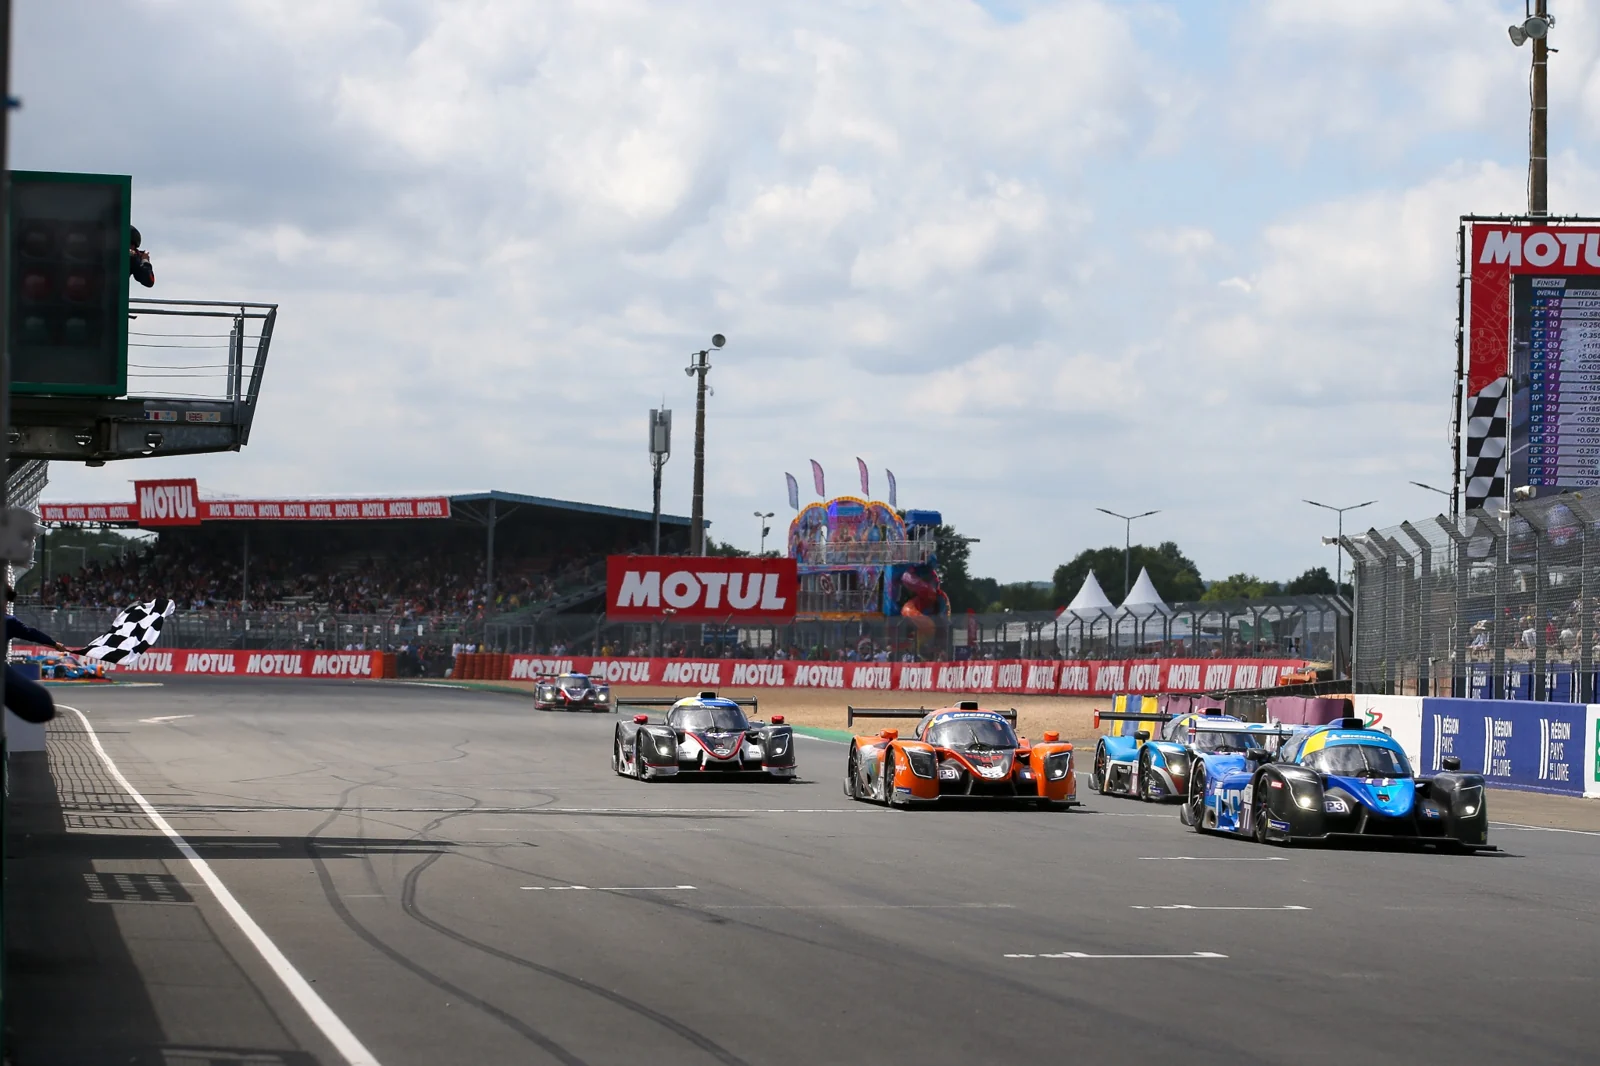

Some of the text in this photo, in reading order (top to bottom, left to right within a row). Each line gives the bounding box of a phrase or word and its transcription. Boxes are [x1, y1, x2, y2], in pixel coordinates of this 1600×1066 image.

[140, 486, 196, 519] MOTUL
[210, 502, 442, 517] MOTUL MOTUL MOTUL MOTUL MOTUL MOTUL MOTUL MOTUL MOTUL
[46, 507, 64, 518] MOTUL
[66, 507, 86, 518] MOTUL
[88, 507, 107, 518] MOTUL
[110, 506, 130, 518] MOTUL
[616, 571, 786, 610] MOTUL
[185, 654, 236, 672] MOTUL
[246, 654, 302, 674] MOTUL
[312, 655, 371, 675] MOTUL
[591, 660, 650, 682] MOTUL
[662, 662, 720, 684] MOTUL
[731, 664, 785, 686] MOTUL
[794, 665, 843, 688] MOTUL
[852, 667, 891, 689] MOTUL
[900, 667, 932, 689] MOTUL
[964, 666, 994, 688] MOTUL
[998, 665, 1022, 688] MOTUL
[1027, 666, 1054, 689] MOTUL
[1060, 666, 1089, 690] MOTUL
[1095, 666, 1124, 691] MOTUL
[1128, 665, 1160, 690] MOTUL
[1168, 665, 1200, 690] MOTUL
[1443, 715, 1459, 734] RÉGION
[1494, 718, 1512, 737] RÉGION
[1550, 719, 1571, 740] RÉGION
[1442, 736, 1453, 753] PAYS
[1493, 740, 1506, 757] PAYS
[1550, 742, 1564, 760] PAYS
[940, 770, 954, 778] P3
[1497, 760, 1511, 777] LOIRE
[1554, 763, 1569, 781] LOIRE
[1327, 802, 1343, 811] P3
